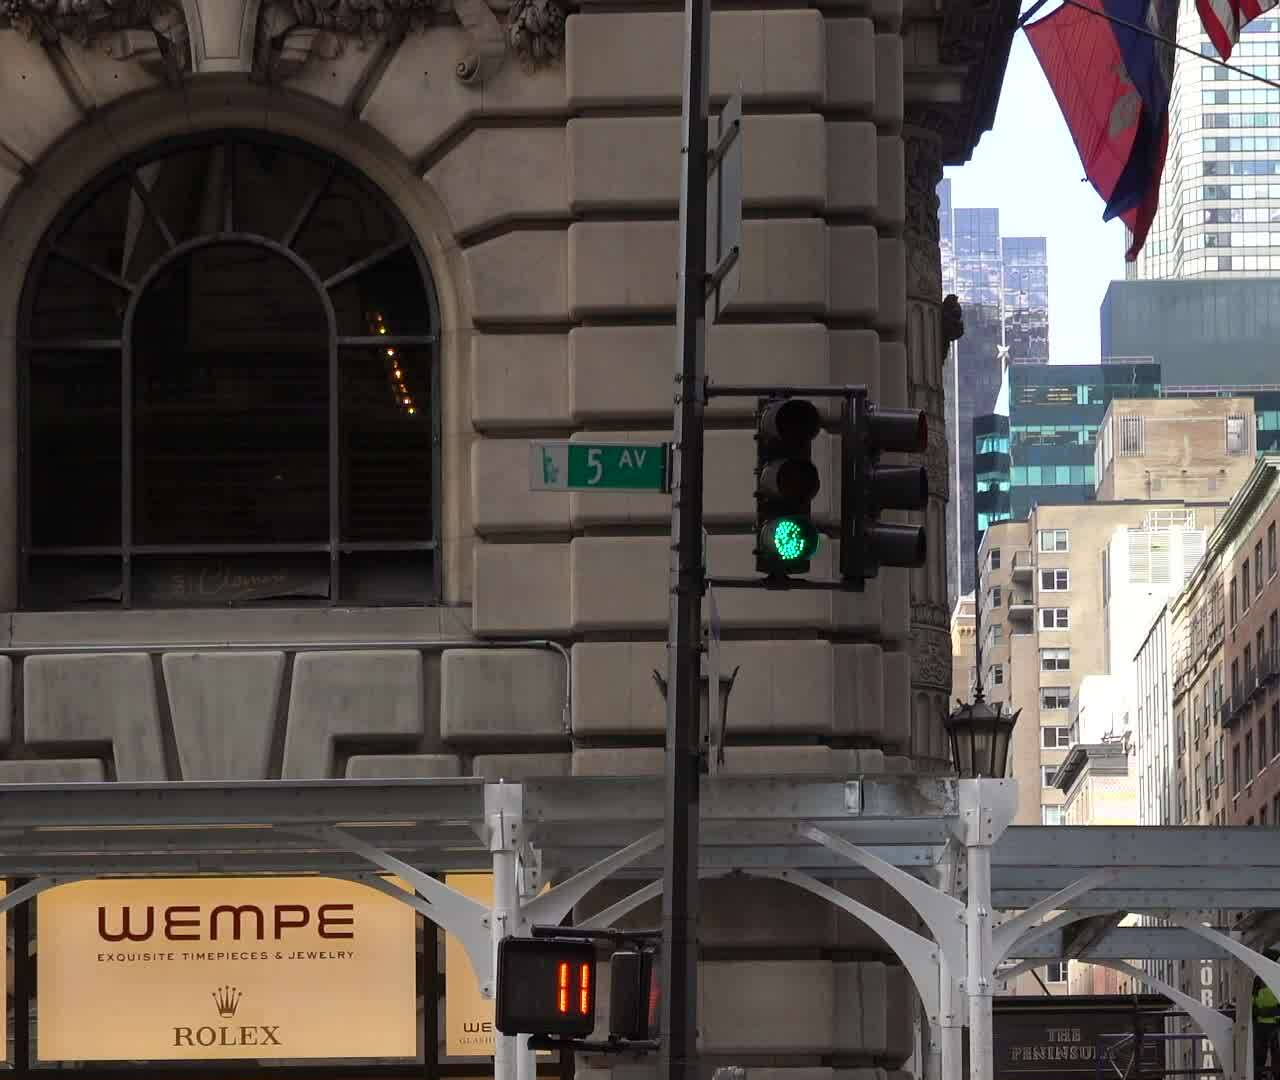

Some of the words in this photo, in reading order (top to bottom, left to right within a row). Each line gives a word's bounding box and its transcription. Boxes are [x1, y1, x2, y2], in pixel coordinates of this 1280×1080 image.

[586, 448, 603, 485] 5
[618, 448, 647, 470] AV
[98, 904, 354, 942] WEMPE
[97, 953, 175, 962] EXQUISITE
[182, 951, 269, 961] TIMEPIECES
[274, 951, 283, 960] &
[288, 951, 355, 960] JEWELRY
[558, 961, 589, 1015] 11
[173, 1026, 282, 1047] ROLEX
[1046, 1028, 1081, 1042] THE
